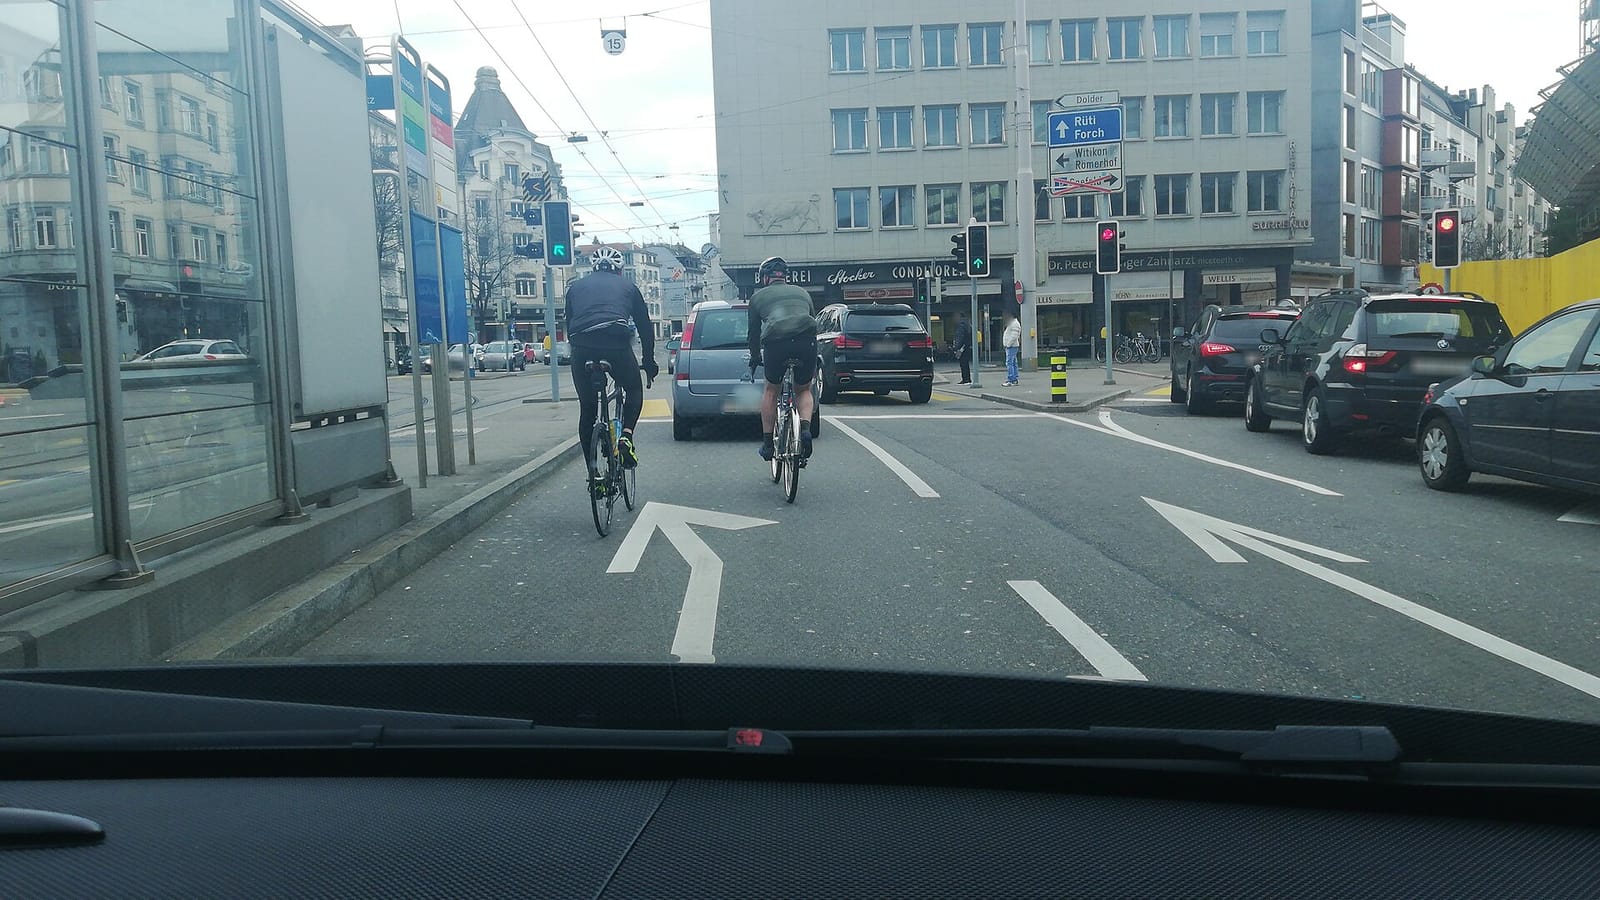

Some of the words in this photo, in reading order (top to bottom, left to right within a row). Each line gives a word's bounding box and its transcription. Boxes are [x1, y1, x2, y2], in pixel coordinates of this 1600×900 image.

[608, 38, 621, 50] 15
[1076, 95, 1103, 104] Dolder
[1074, 115, 1096, 127] Rüti
[1074, 127, 1105, 140] Forch
[1074, 147, 1108, 158] Witikon
[1075, 157, 1118, 170] Römerhof
[1048, 261, 1063, 270] Dr.
[1065, 260, 1093, 269] Peter
[827, 268, 875, 285] Stocker
[1208, 275, 1236, 283] WELLIS
